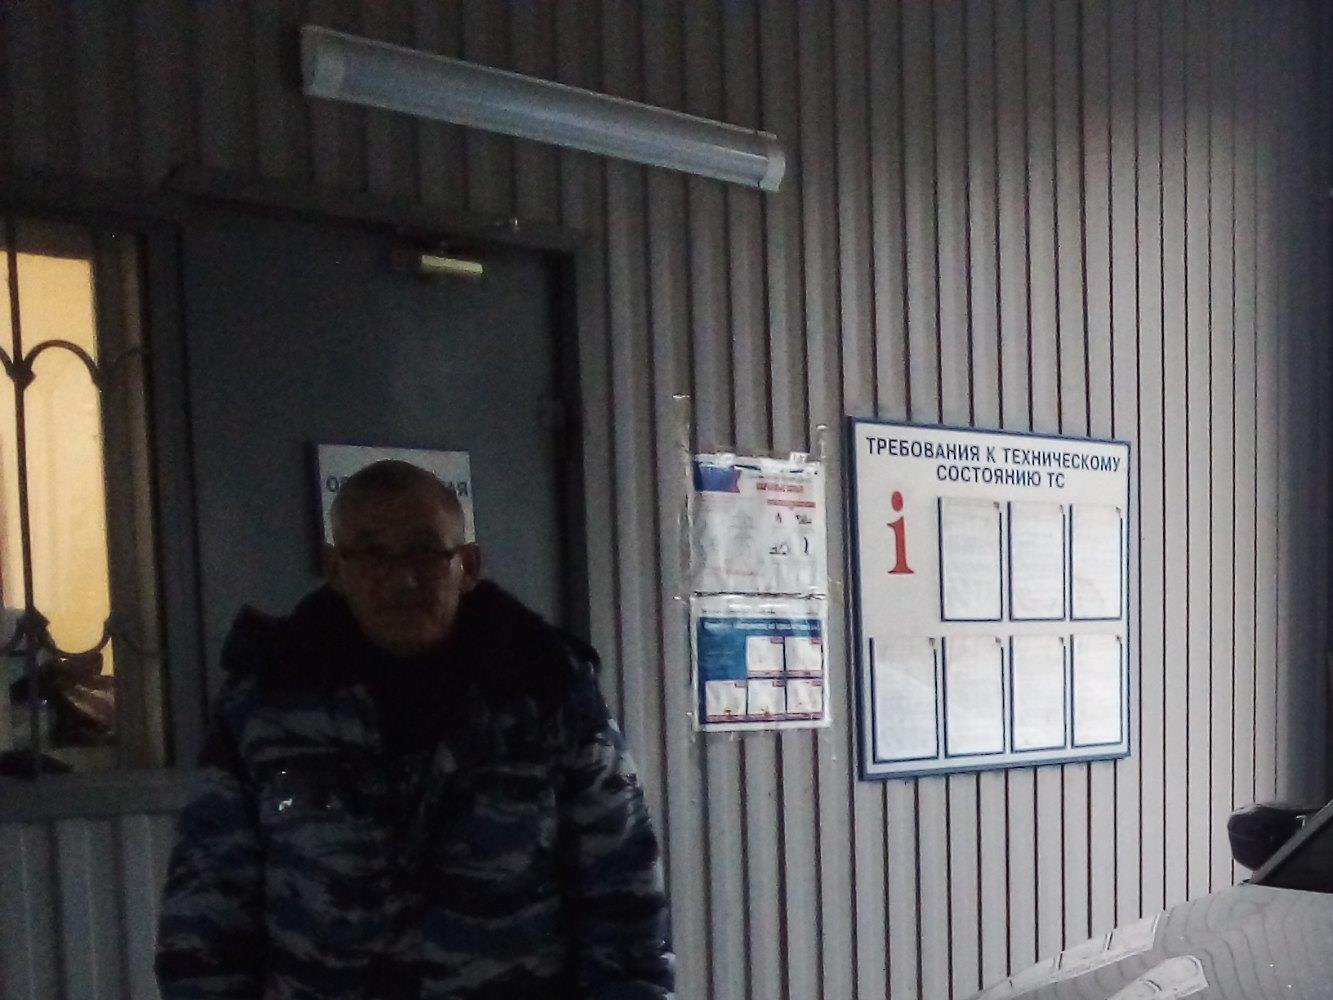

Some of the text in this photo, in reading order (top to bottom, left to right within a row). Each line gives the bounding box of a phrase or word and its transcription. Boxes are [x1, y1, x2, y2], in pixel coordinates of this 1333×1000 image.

[866, 437, 1121, 473] ТРЕБОВАНИЯ К ТЕХНИЧЕСКОМУ
[937, 465, 1065, 488] СОСТОЯНИЮ ТС
